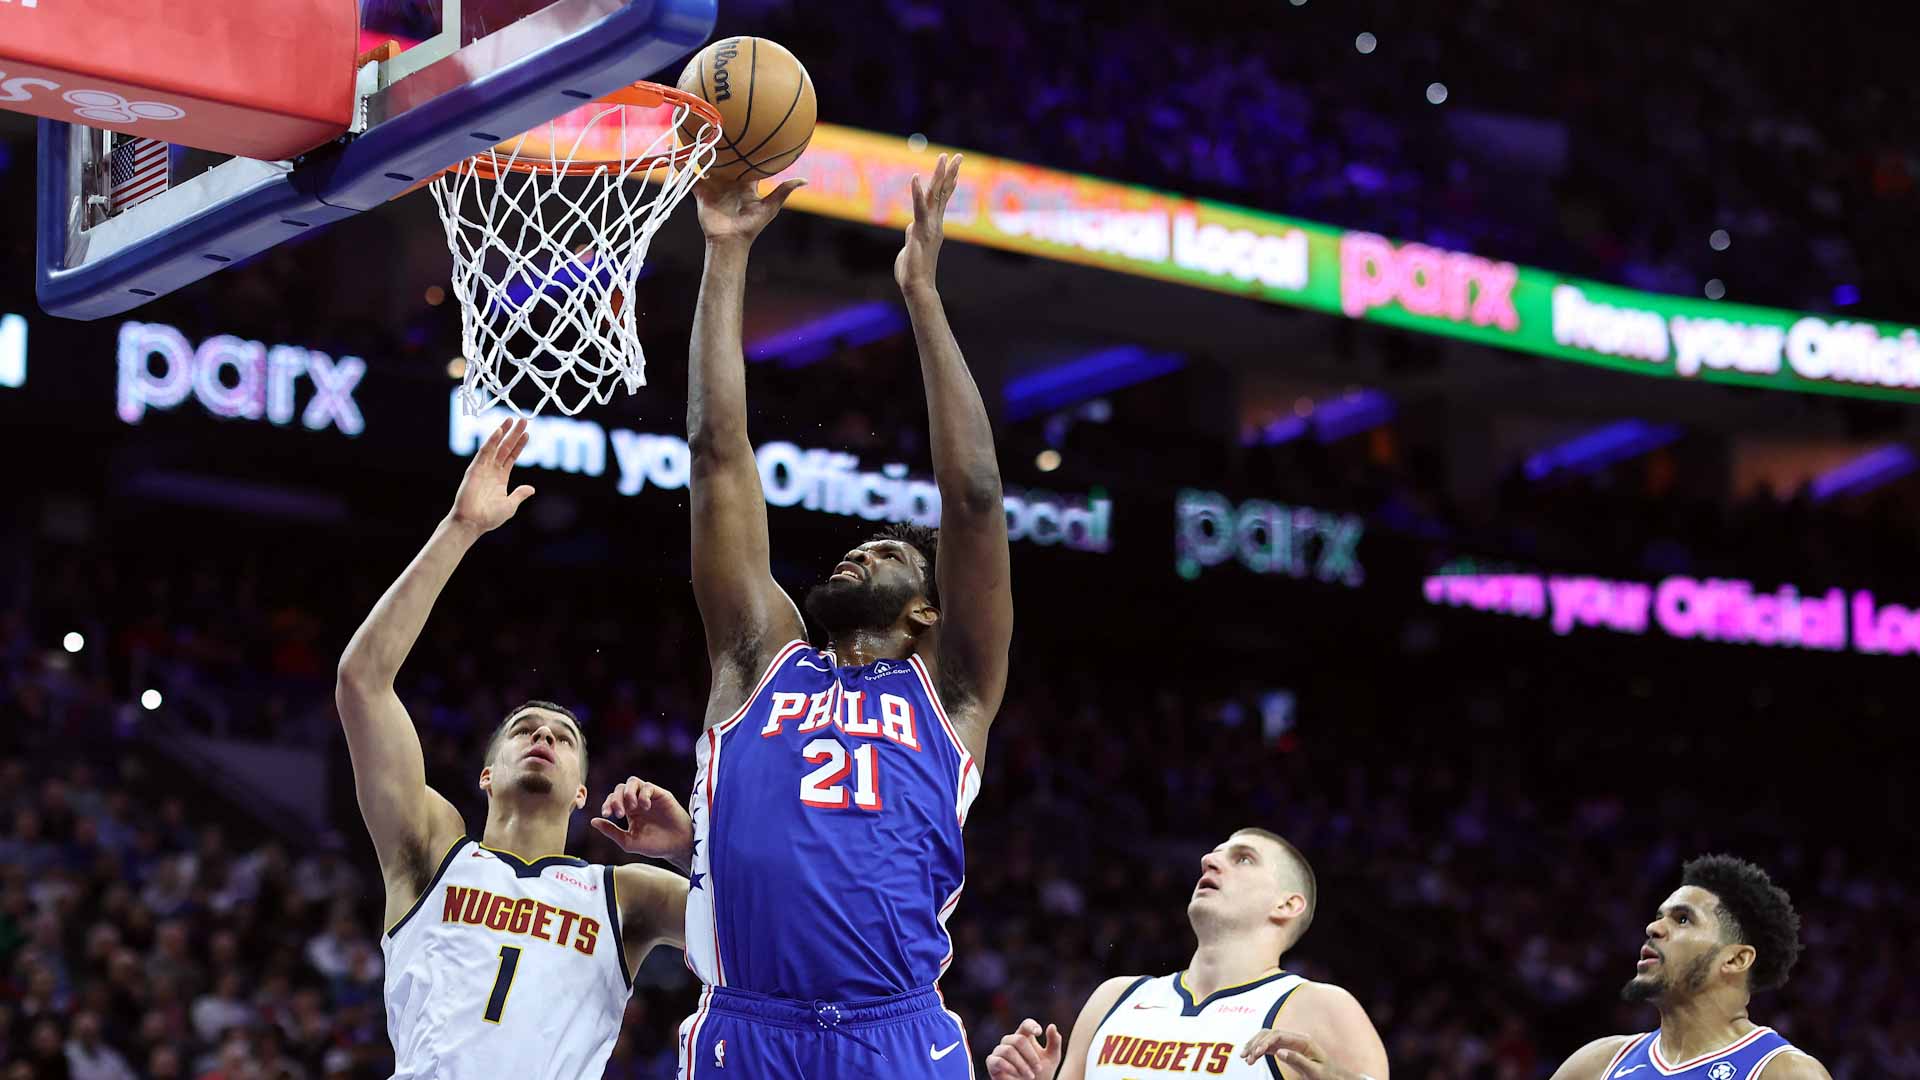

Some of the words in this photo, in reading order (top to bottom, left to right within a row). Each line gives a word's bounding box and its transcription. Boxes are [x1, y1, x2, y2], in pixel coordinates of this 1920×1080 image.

[1340, 230, 1519, 333] parx
[116, 320, 367, 436] parx
[1786, 317, 1920, 388] Offici
[755, 440, 943, 527] Officia
[1002, 486, 1114, 552] ocal
[1174, 487, 1366, 588] parx
[761, 680, 921, 752] PHILA
[800, 738, 882, 811] 21
[442, 886, 600, 956] NUGGETS
[483, 944, 524, 1024] 1
[1097, 1034, 1234, 1075] NUGGETS
